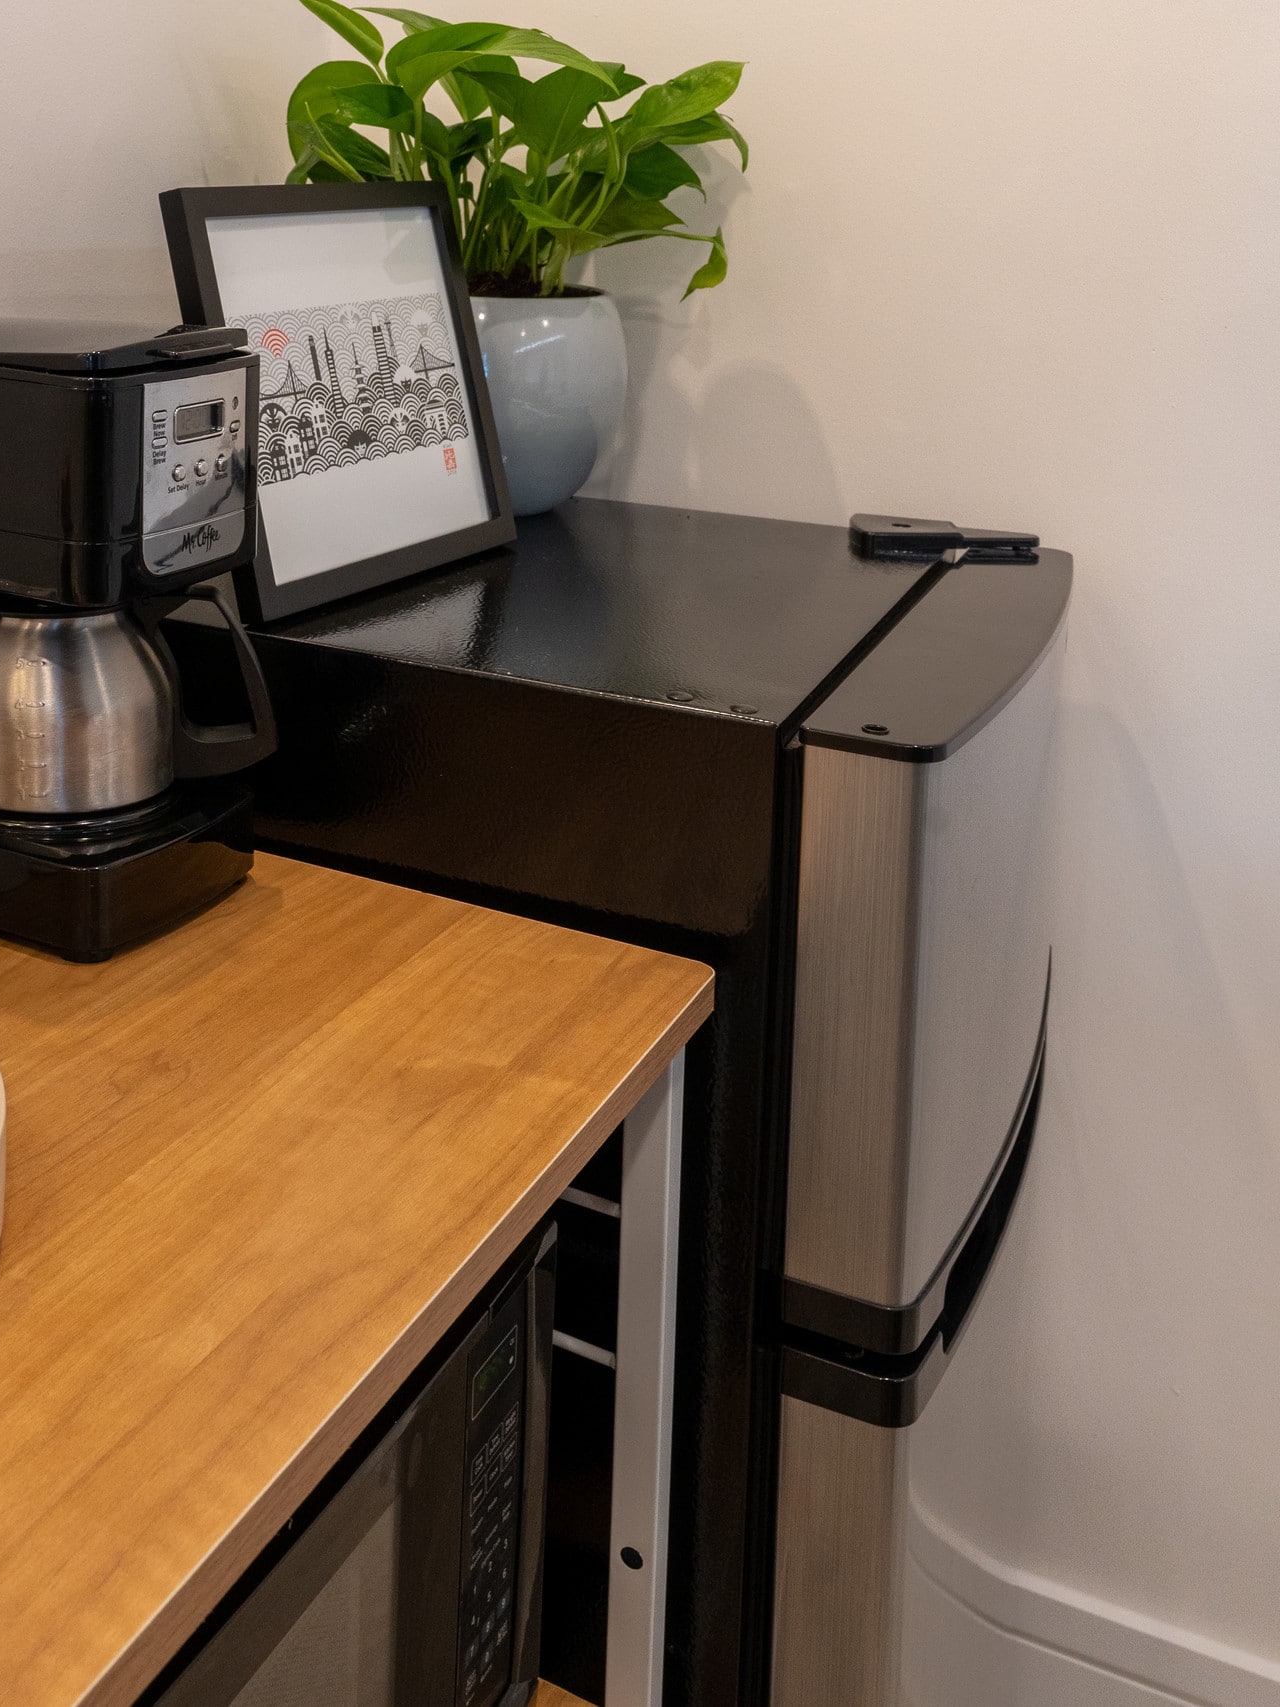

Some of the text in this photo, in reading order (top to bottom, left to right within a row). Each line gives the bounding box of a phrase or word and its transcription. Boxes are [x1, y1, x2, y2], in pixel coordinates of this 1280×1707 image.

[153, 458, 166, 466] Brew
[176, 484, 190, 492] Delay
[196, 524, 221, 552] Coffee
